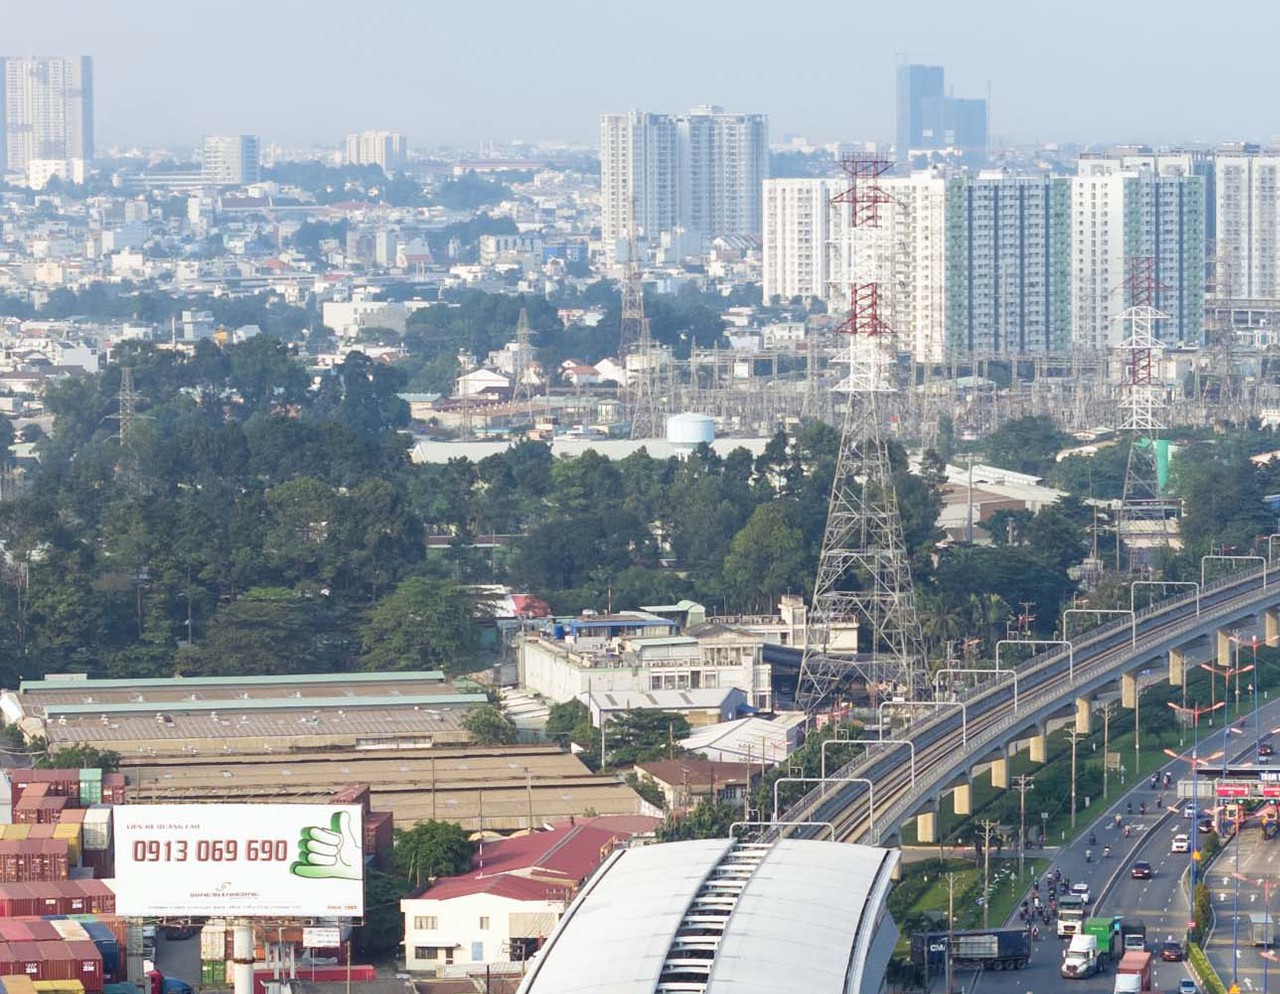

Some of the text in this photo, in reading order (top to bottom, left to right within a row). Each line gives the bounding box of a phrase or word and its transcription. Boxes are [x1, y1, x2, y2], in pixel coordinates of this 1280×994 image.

[133, 840, 288, 862] 0913 069 690
